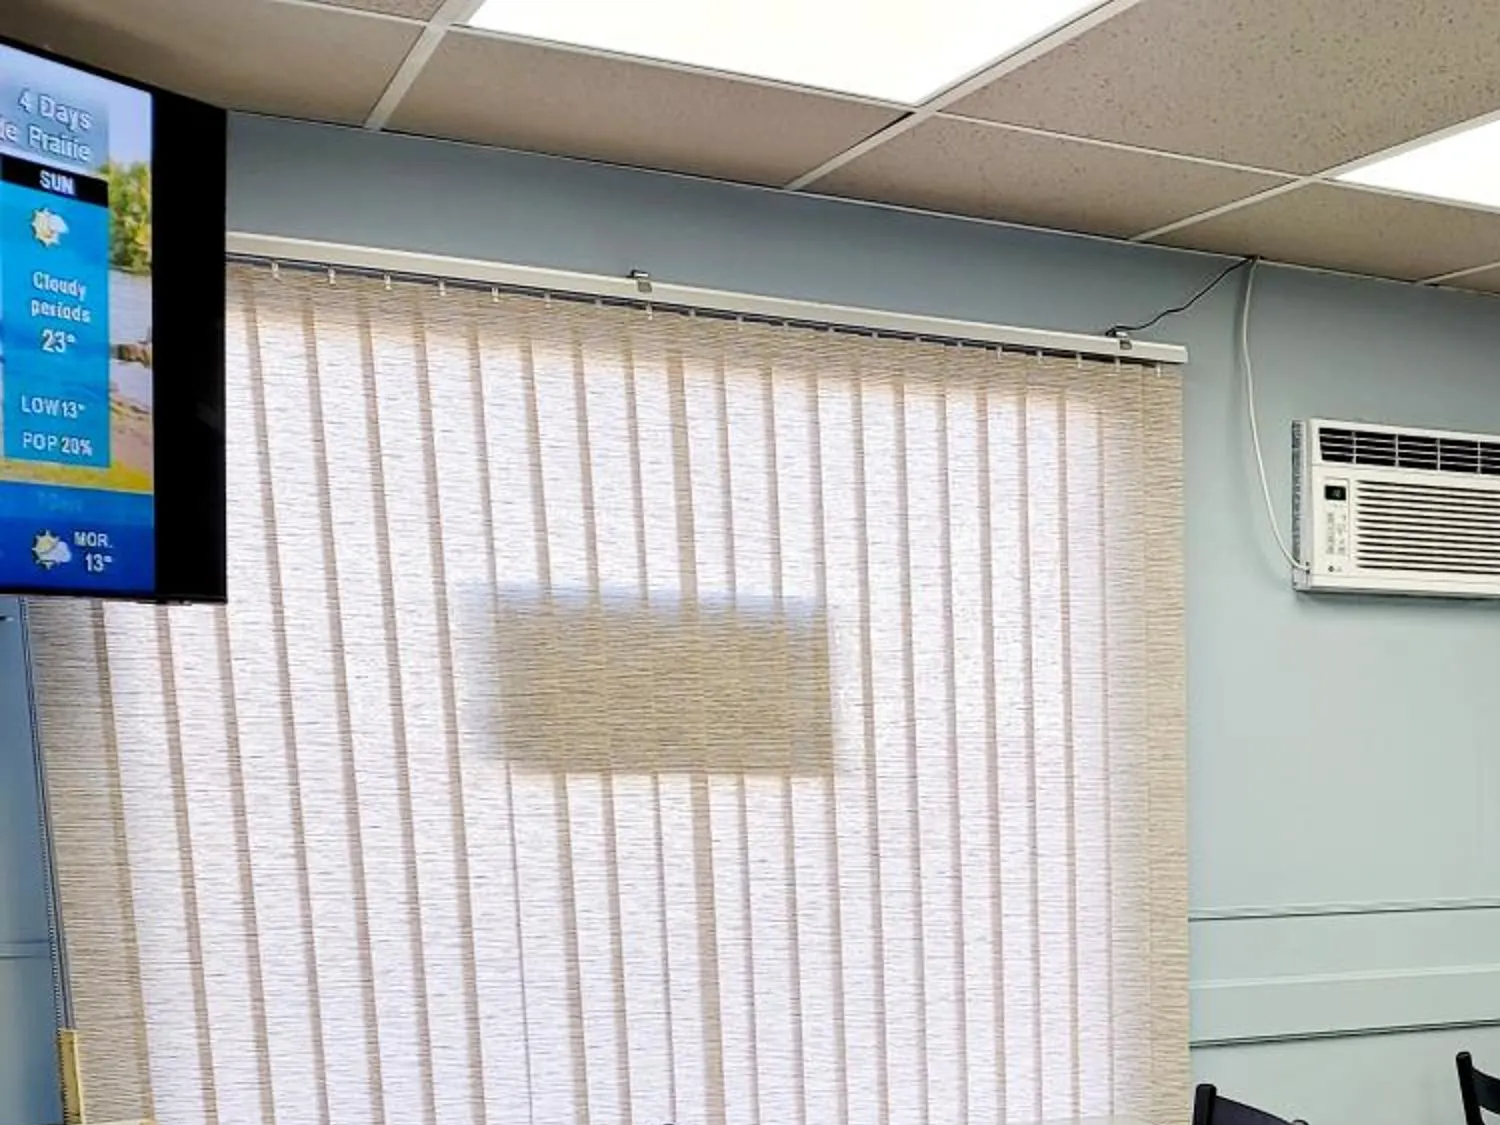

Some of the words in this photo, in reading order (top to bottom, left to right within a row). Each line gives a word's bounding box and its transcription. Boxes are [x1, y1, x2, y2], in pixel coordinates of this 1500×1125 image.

[18, 90, 31, 114] 4
[39, 95, 92, 132] Days
[28, 123, 92, 162] Prairie
[40, 169, 76, 196] SUN
[33, 271, 87, 301] Cloudy
[31, 299, 92, 323] periods
[21, 395, 60, 417] LOW
[23, 431, 58, 452] POP
